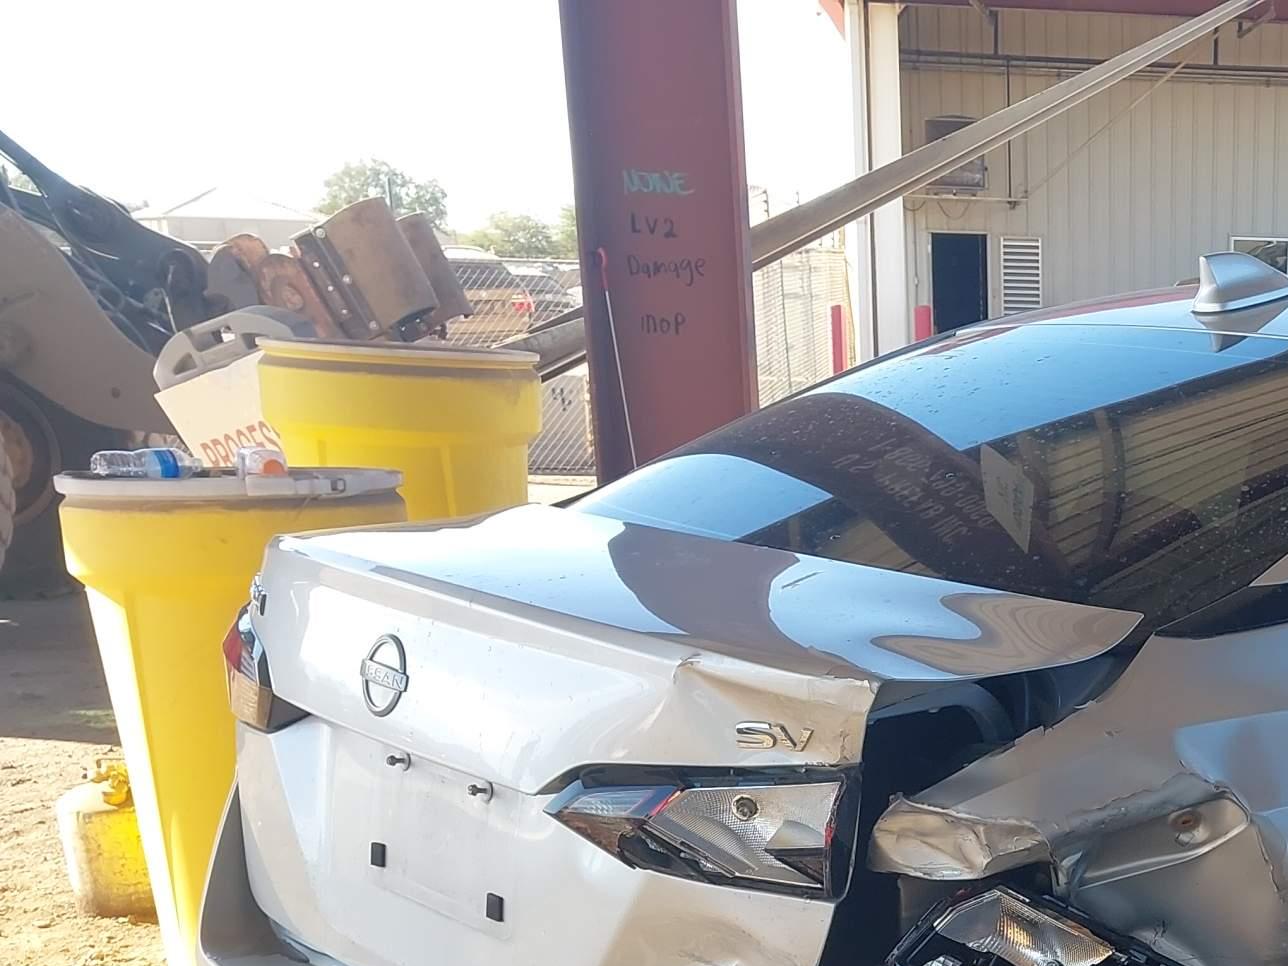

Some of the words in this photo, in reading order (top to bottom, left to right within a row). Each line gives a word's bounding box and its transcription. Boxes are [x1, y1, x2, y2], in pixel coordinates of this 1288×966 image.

[627, 254, 705, 287] Damage
[361, 659, 405, 691] SSAN
[735, 720, 815, 752] SV
